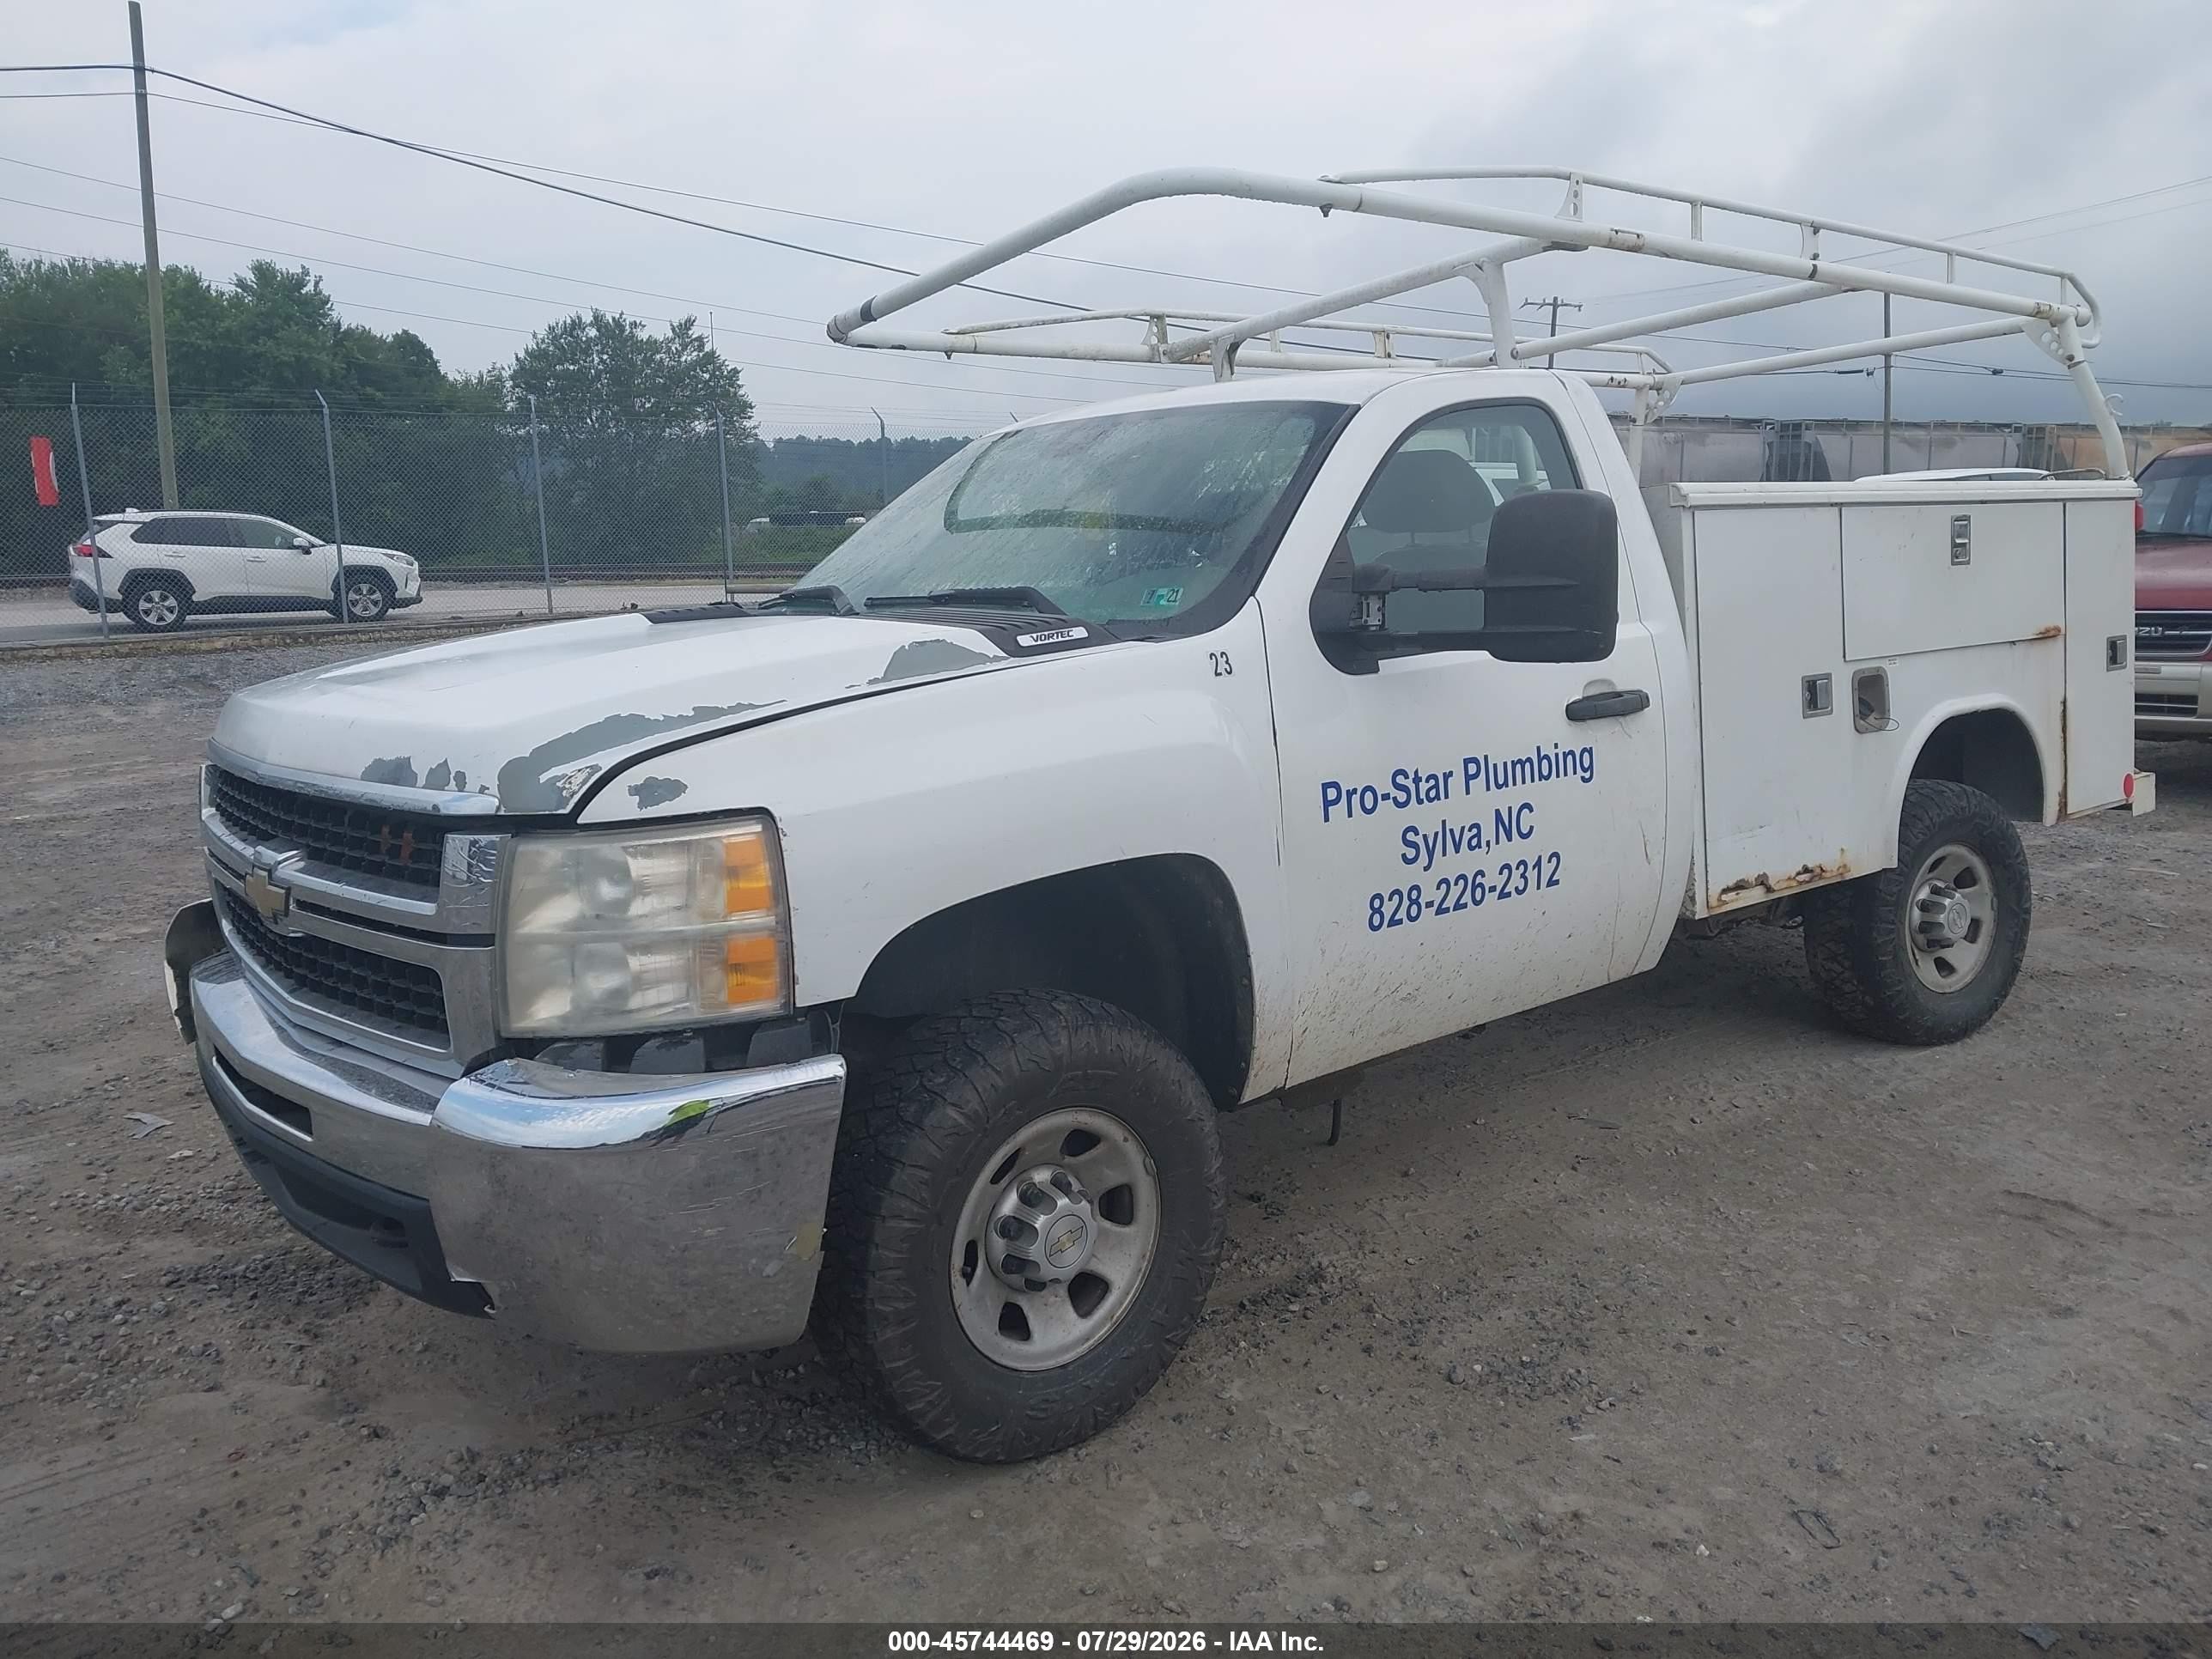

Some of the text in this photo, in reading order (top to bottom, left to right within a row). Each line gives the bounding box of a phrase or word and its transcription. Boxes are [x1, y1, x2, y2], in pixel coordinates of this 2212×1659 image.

[1166, 588, 1180, 603] 21
[1030, 629, 1074, 642] VORTEC
[1209, 651, 1233, 677] 23
[1321, 743, 1595, 823] Pro-Star Plumbing
[1401, 802, 1535, 872] Sylva,NC
[1367, 851, 1562, 933] 828-226-2312
